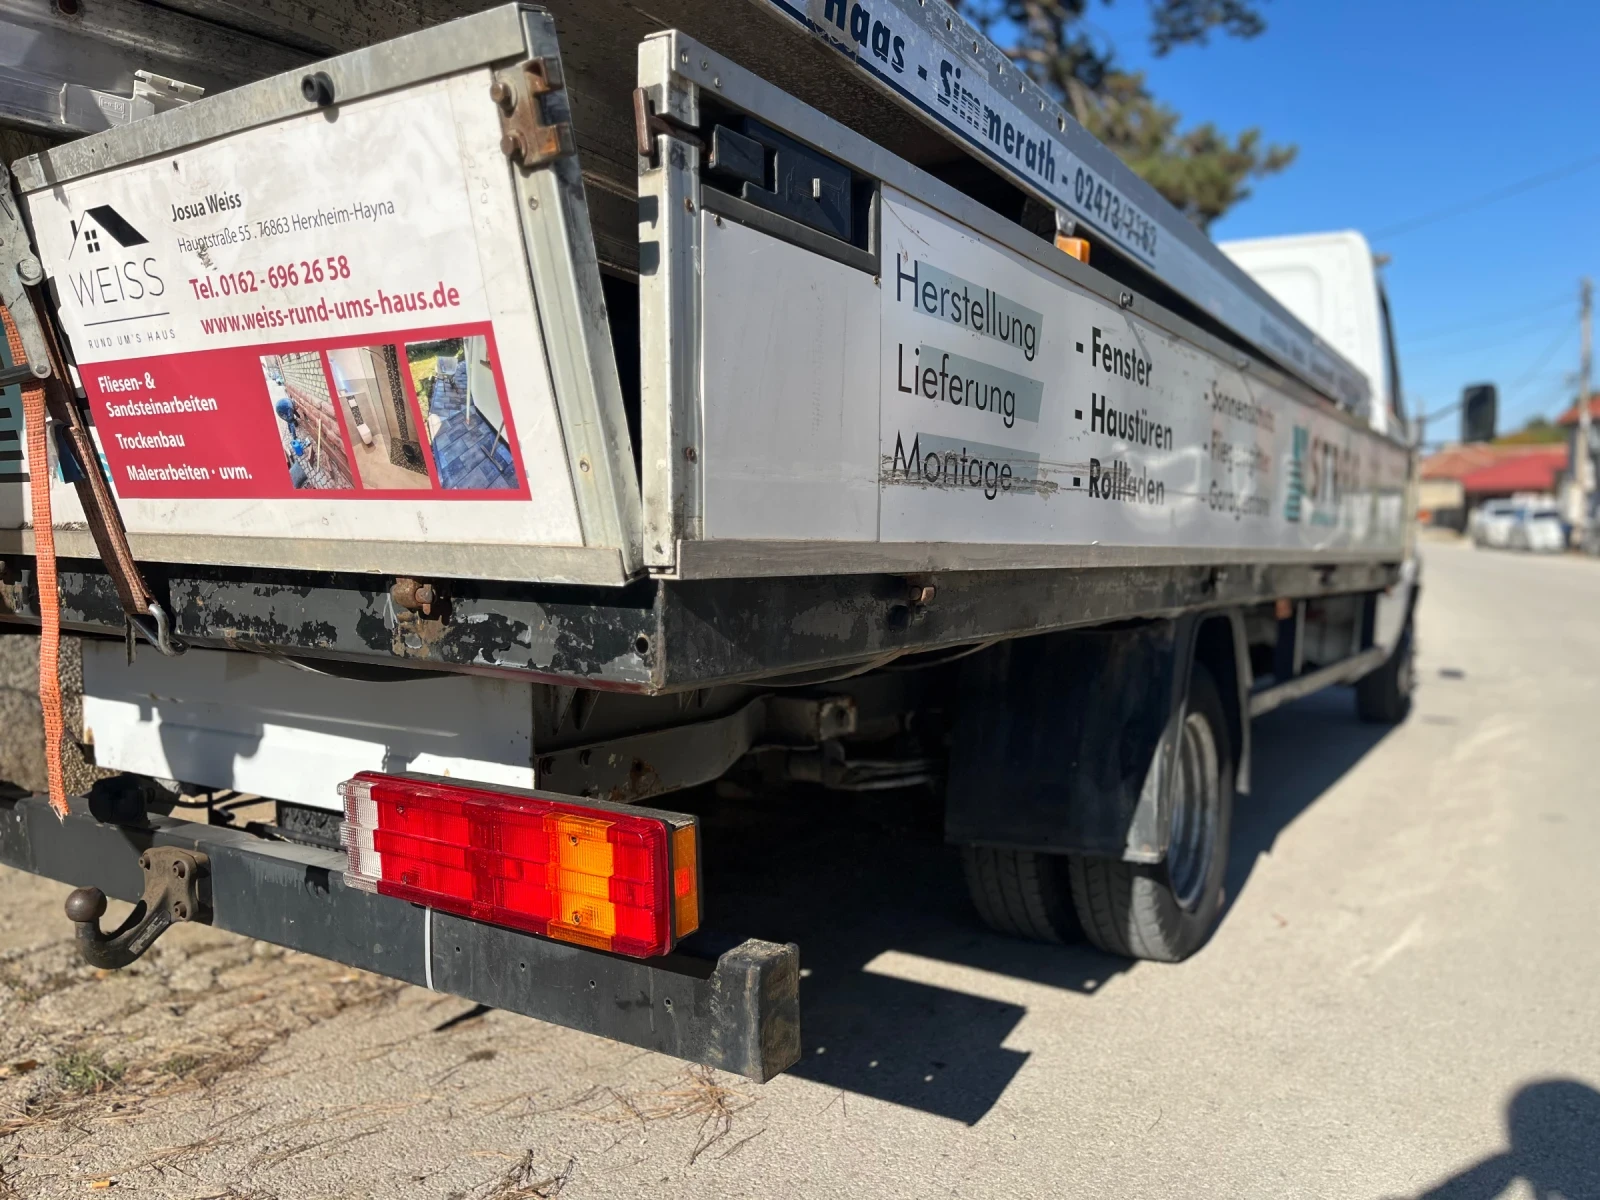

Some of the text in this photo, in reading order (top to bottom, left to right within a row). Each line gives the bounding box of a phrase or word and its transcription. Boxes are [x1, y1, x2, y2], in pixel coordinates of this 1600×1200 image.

[823, 0, 906, 74] Haas
[937, 59, 1056, 185] Simmerath
[171, 191, 242, 222] Josua Weiss
[177, 227, 237, 253] Hauptstraße
[238, 225, 252, 242] 55
[257, 216, 290, 238] 76863
[291, 200, 395, 232] Herxheim-Hayna
[69, 257, 165, 308] WEISS
[189, 275, 219, 301] Tel.
[219, 270, 258, 297] 0162
[268, 262, 299, 289] 696
[300, 259, 324, 285] 26
[326, 255, 351, 281] 58
[200, 281, 460, 335] www.weiss-rund-ums-haus.de
[896, 252, 1036, 361] Herstellung
[88, 328, 176, 349] RUND UM'S HAUS
[1092, 326, 1153, 387] Fenster
[98, 372, 156, 393] Fliesen- &
[105, 395, 219, 417] Sandsteinarbeiten
[898, 343, 1016, 429] Lieferung
[115, 430, 186, 450] Trockenbau
[1091, 392, 1173, 452] Haustüren
[126, 463, 210, 481] Malerarbeiten
[219, 466, 252, 480] uvm.
[892, 429, 1013, 500] Montage
